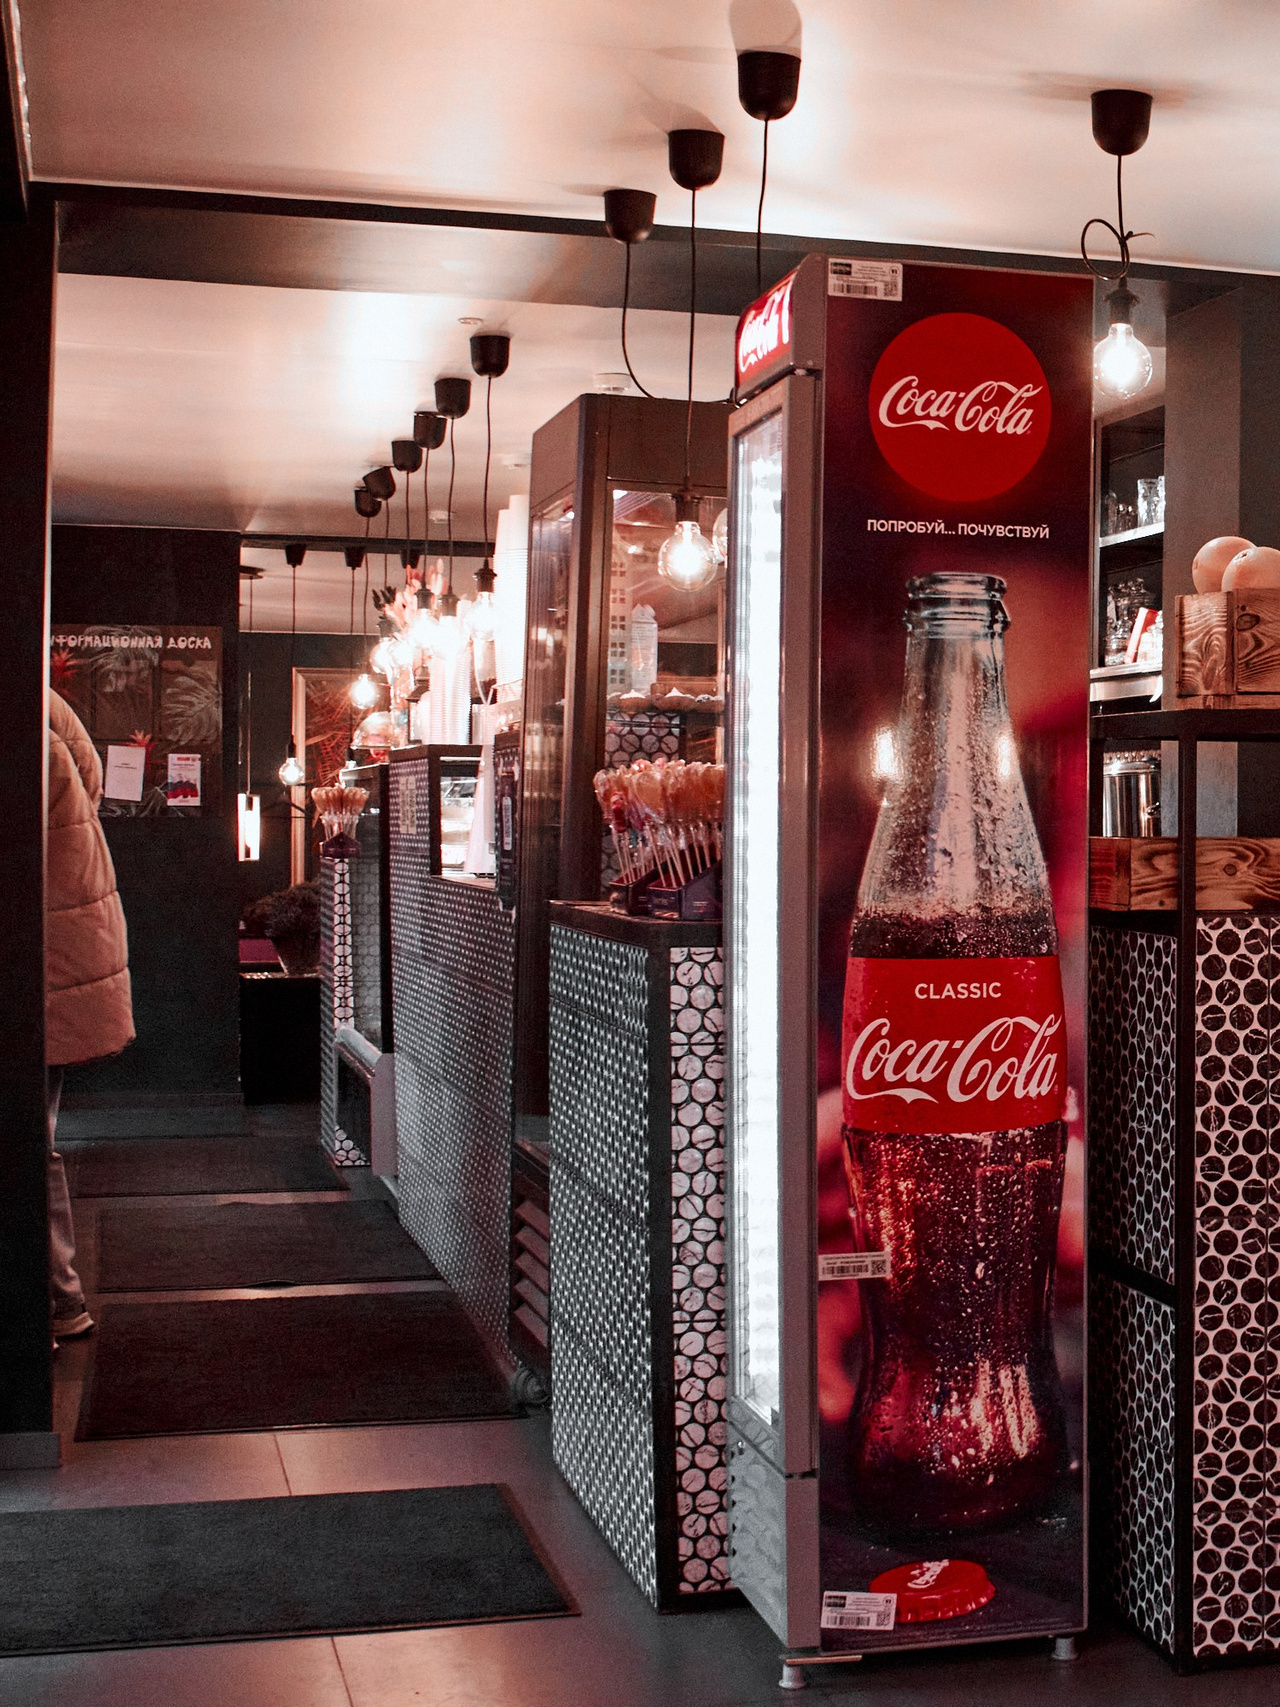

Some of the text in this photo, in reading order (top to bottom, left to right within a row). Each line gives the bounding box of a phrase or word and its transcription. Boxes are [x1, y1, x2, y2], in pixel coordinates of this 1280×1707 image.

[878, 375, 1043, 435] Coca-Cola
[867, 518, 1049, 540] ПОПРОБУЙ... ПОЧУВСТВУЙ
[167, 636, 212, 649] ДОСКА
[914, 982, 1002, 1000] CLASSIC
[846, 1013, 1063, 1104] Coca-Cola
